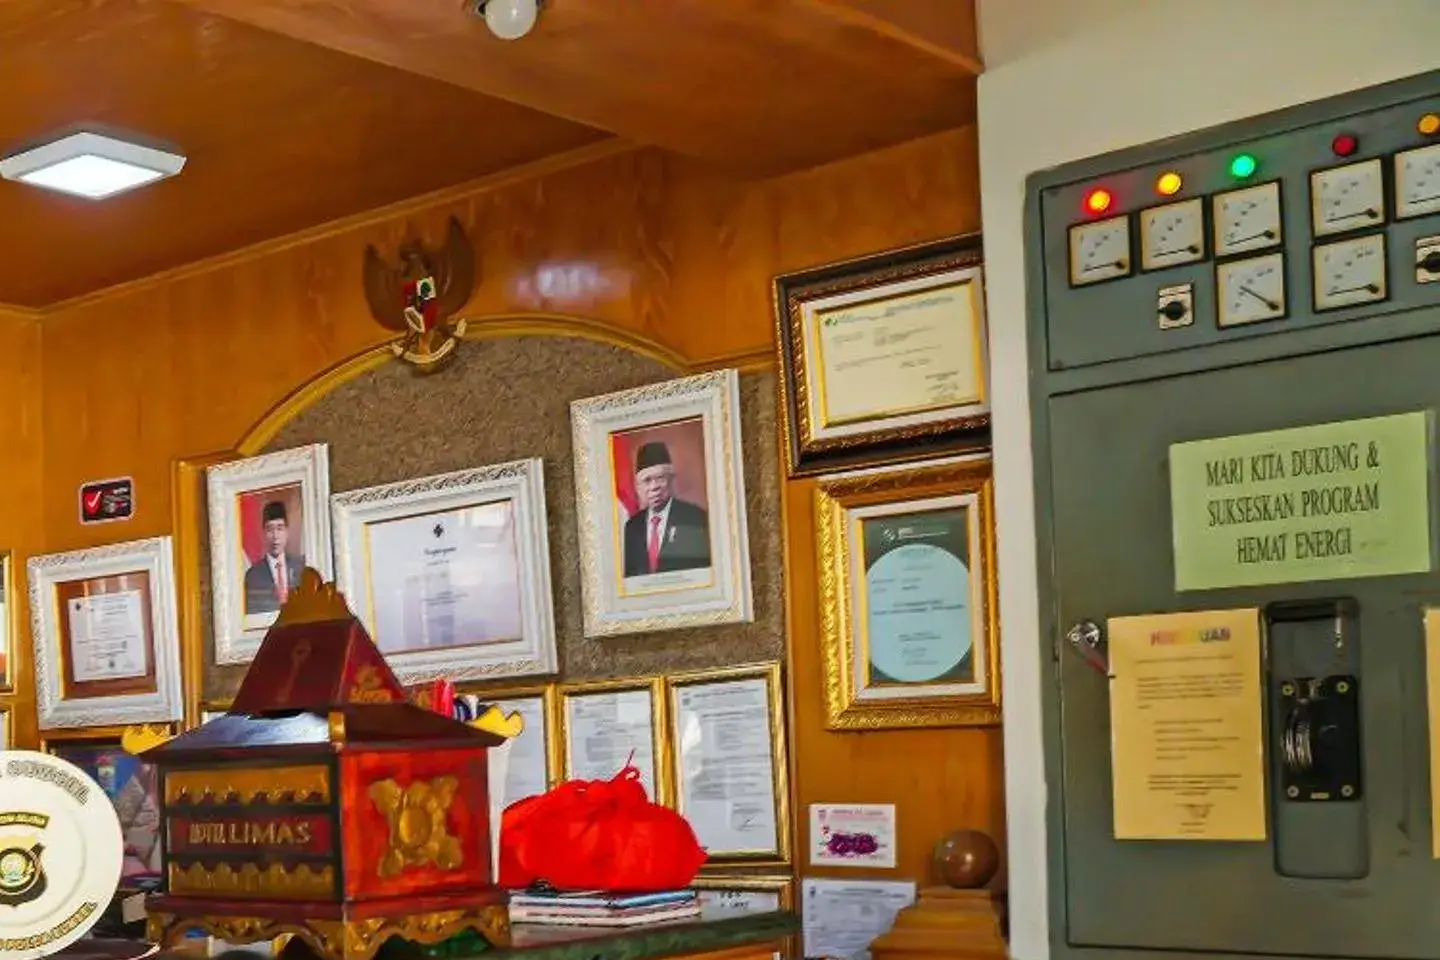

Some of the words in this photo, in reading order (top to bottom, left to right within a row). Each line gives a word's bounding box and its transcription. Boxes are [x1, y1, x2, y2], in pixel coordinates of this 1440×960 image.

[1205, 458, 1243, 487] MARI
[1250, 452, 1285, 483] KITA
[1291, 443, 1359, 478] DUKUNG
[1366, 441, 1380, 468] &
[1207, 492, 1295, 527] SUKSESKAN
[1301, 482, 1380, 518] PROGRAM
[1237, 533, 1287, 564] HEMAT
[1296, 528, 1352, 561] ENERGI
[228, 821, 312, 845] LIMAS
